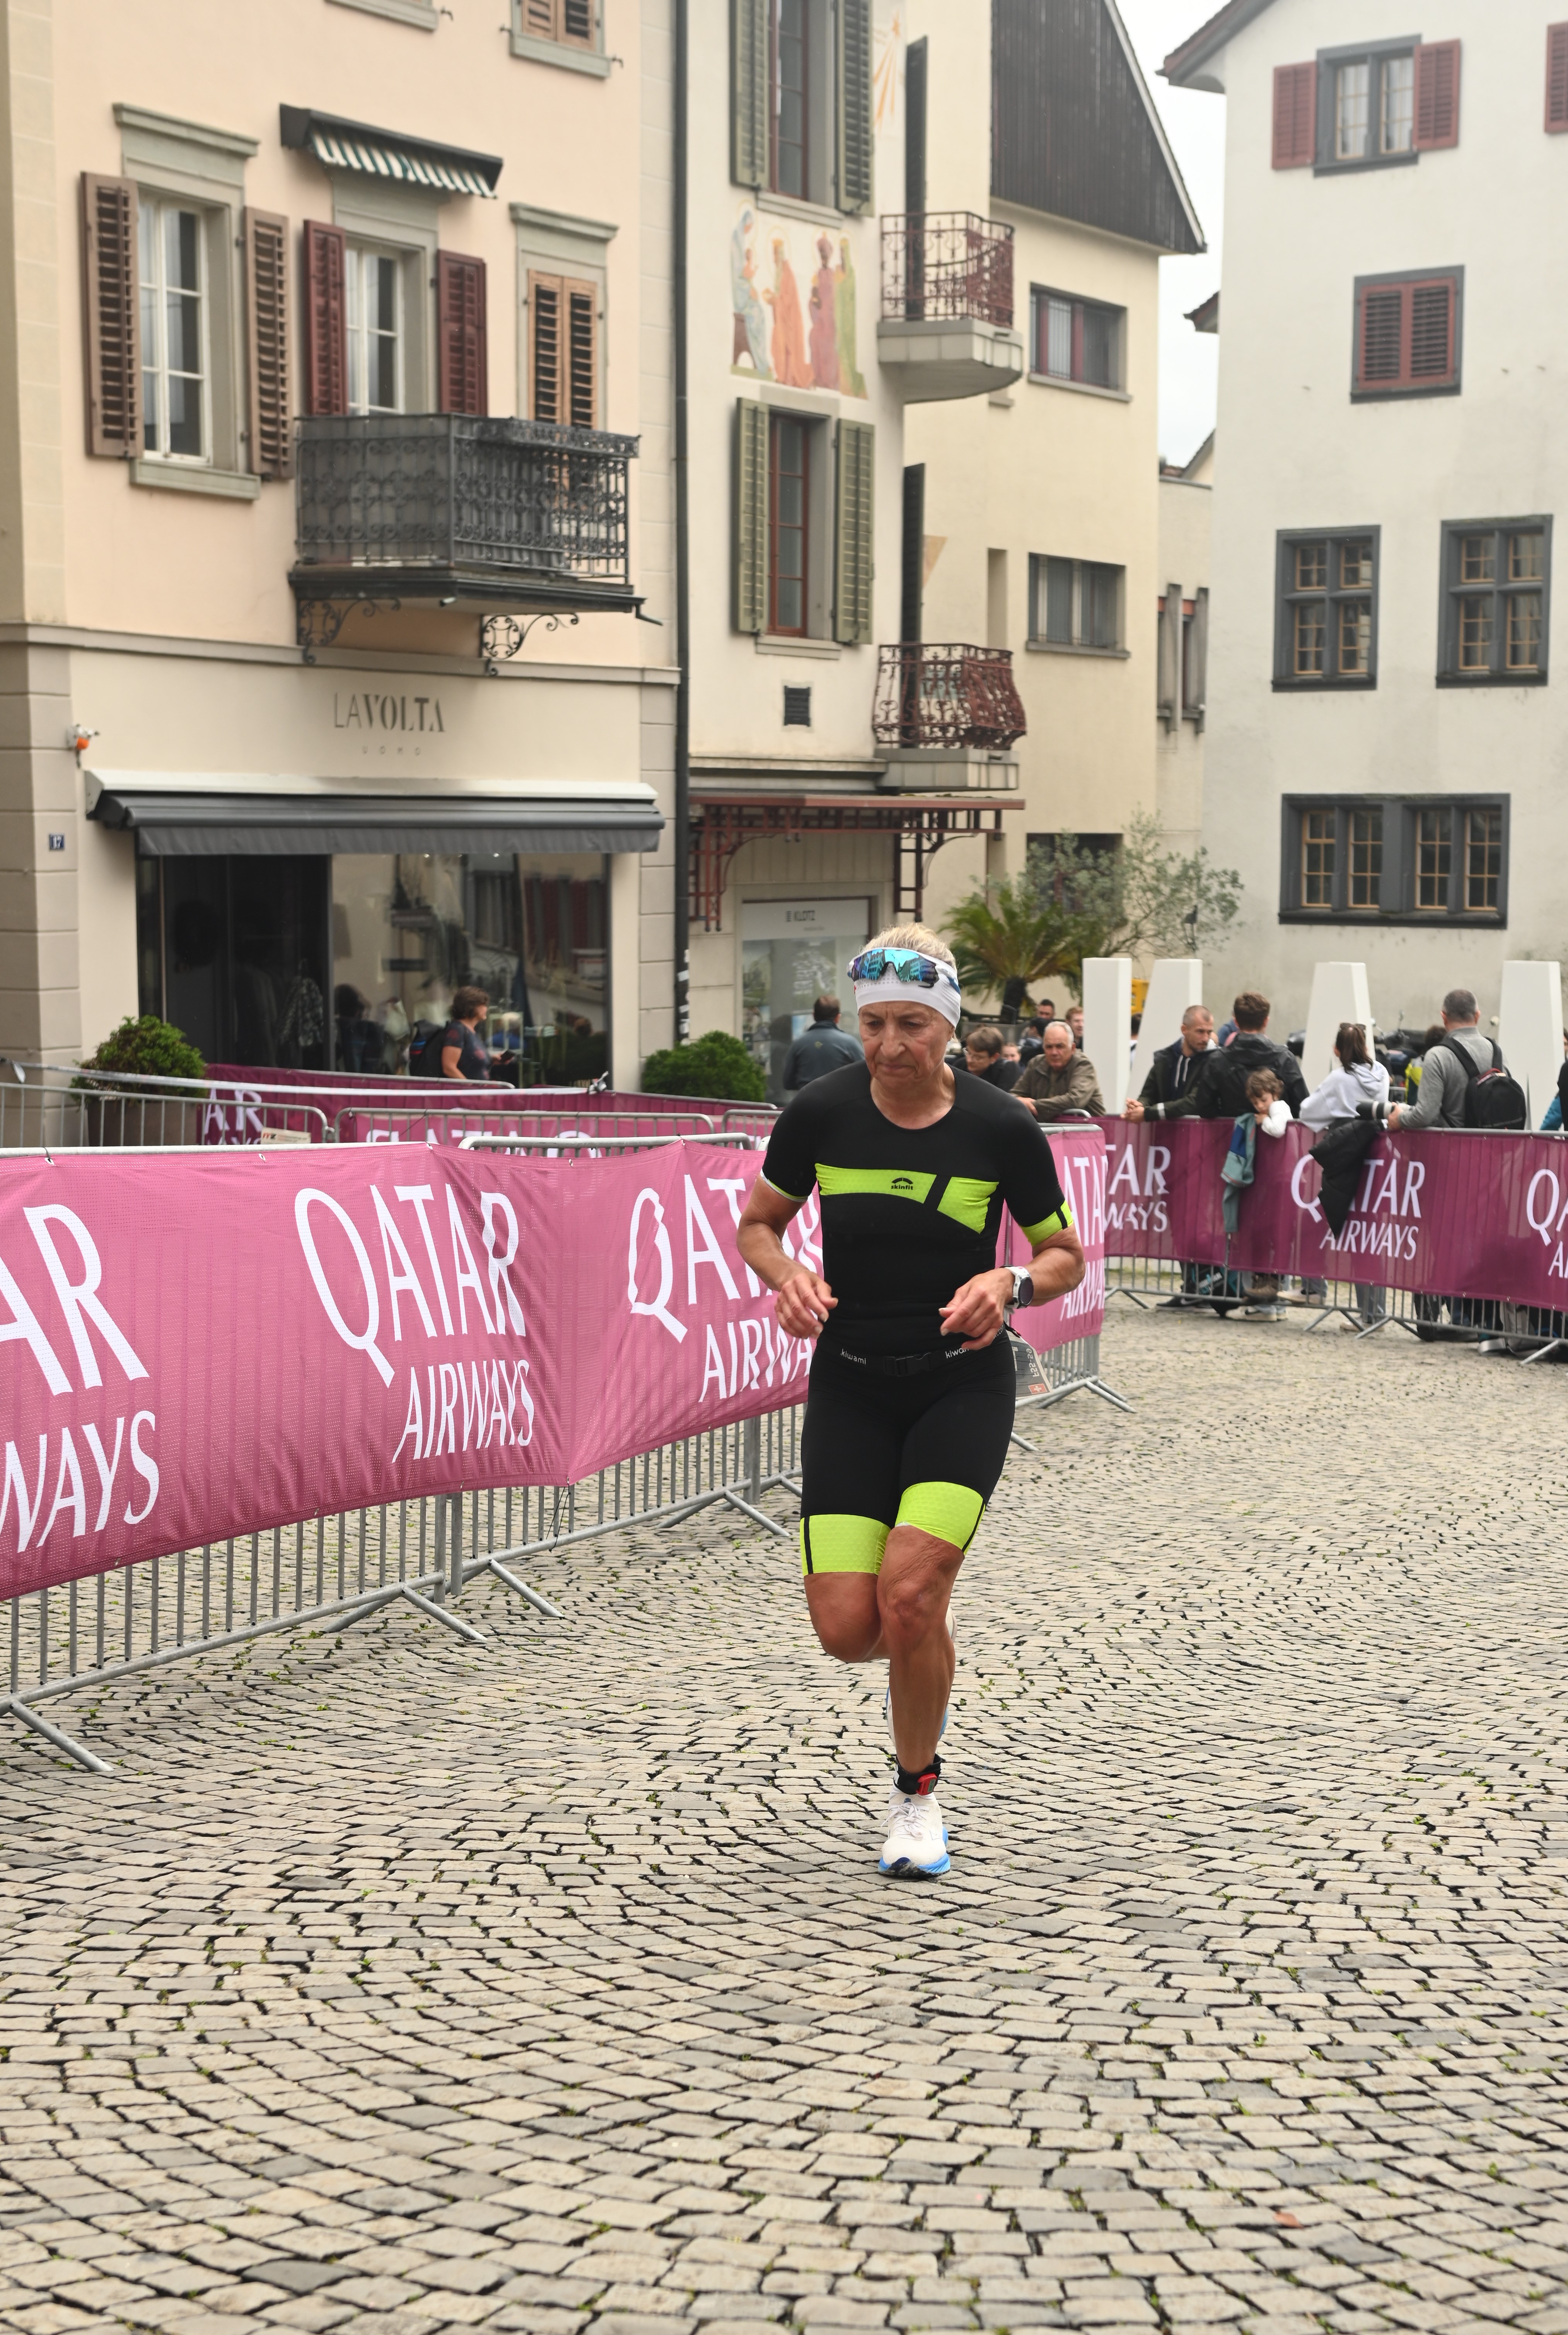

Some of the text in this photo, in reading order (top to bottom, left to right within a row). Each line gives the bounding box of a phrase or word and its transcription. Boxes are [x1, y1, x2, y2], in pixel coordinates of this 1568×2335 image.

[363, 745, 421, 756] UOMO
[52, 836, 62, 849] 17
[1105, 1144, 1170, 1196] AR
[1291, 1154, 1425, 1222] QTAR
[1319, 1220, 1419, 1260] AIRWAYS
[295, 1183, 526, 1388] QATAR
[698, 1309, 818, 1403] AIRWA
[945, 1348, 969, 1359] kiwa
[392, 1359, 535, 1463] AIRWAYS
